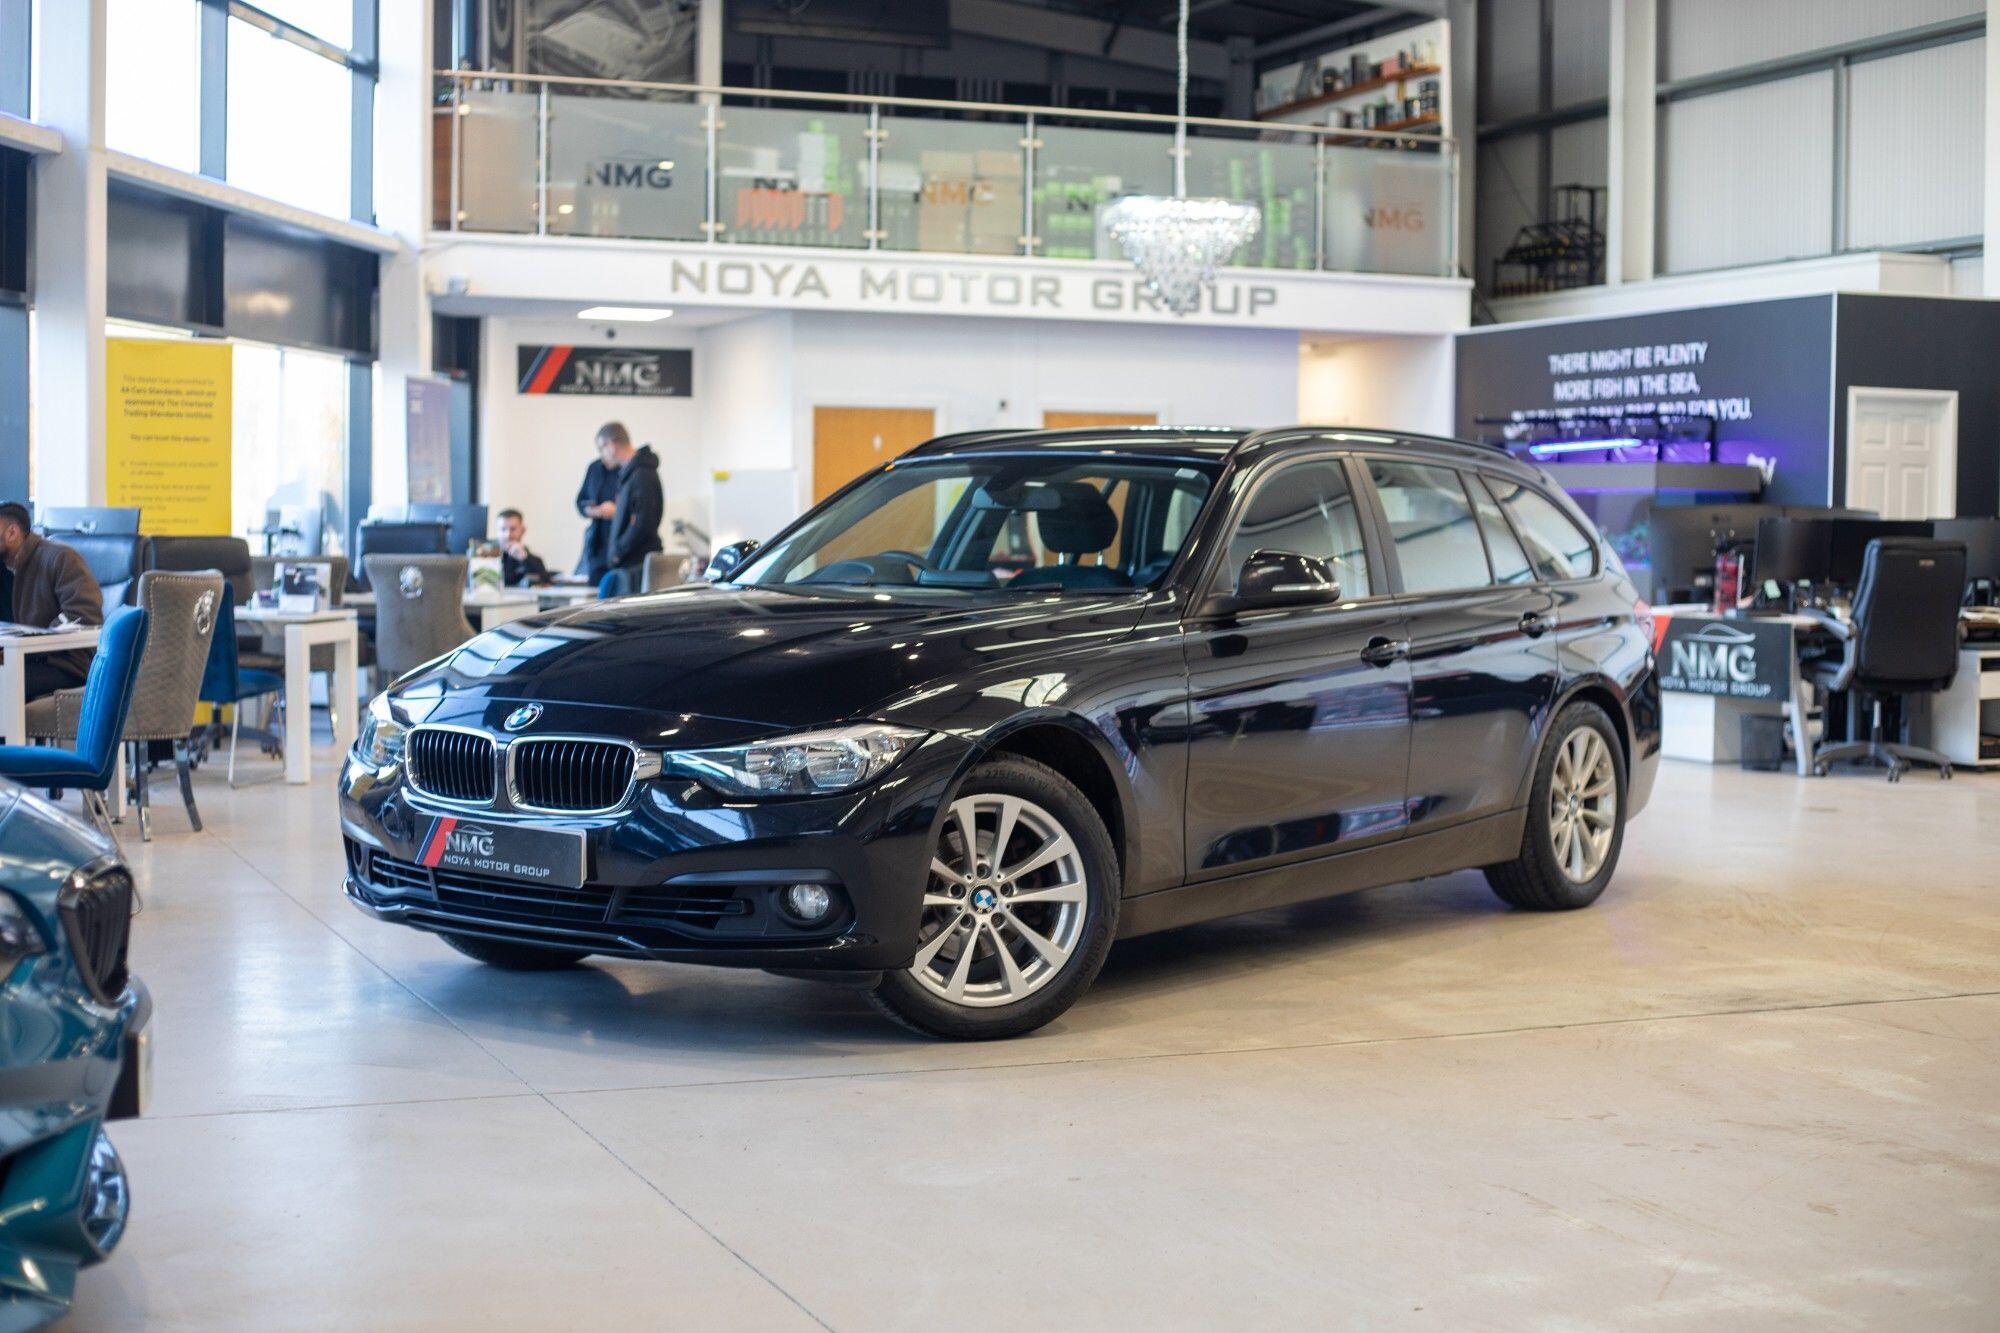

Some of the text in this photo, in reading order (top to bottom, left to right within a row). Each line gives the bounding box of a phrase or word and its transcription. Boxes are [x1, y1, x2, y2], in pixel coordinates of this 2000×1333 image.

[584, 163, 675, 189] NMG
[671, 258, 830, 299] NOYA
[860, 267, 1063, 308] MOTOR
[1549, 342, 1708, 375] THERE MIGHT BE PLENTY
[574, 360, 661, 387] NMG
[1553, 379, 1593, 401] MORE
[1593, 376, 1623, 398] FISH
[1624, 376, 1640, 397] IN
[1640, 374, 1668, 395] THE
[1671, 640, 1757, 682] NMG
[1688, 679, 1728, 694] MOTOR
[1729, 682, 1771, 698] GROUP
[445, 831, 495, 857] NMG
[444, 854, 550, 878] NOYA MOTOR GROUP
